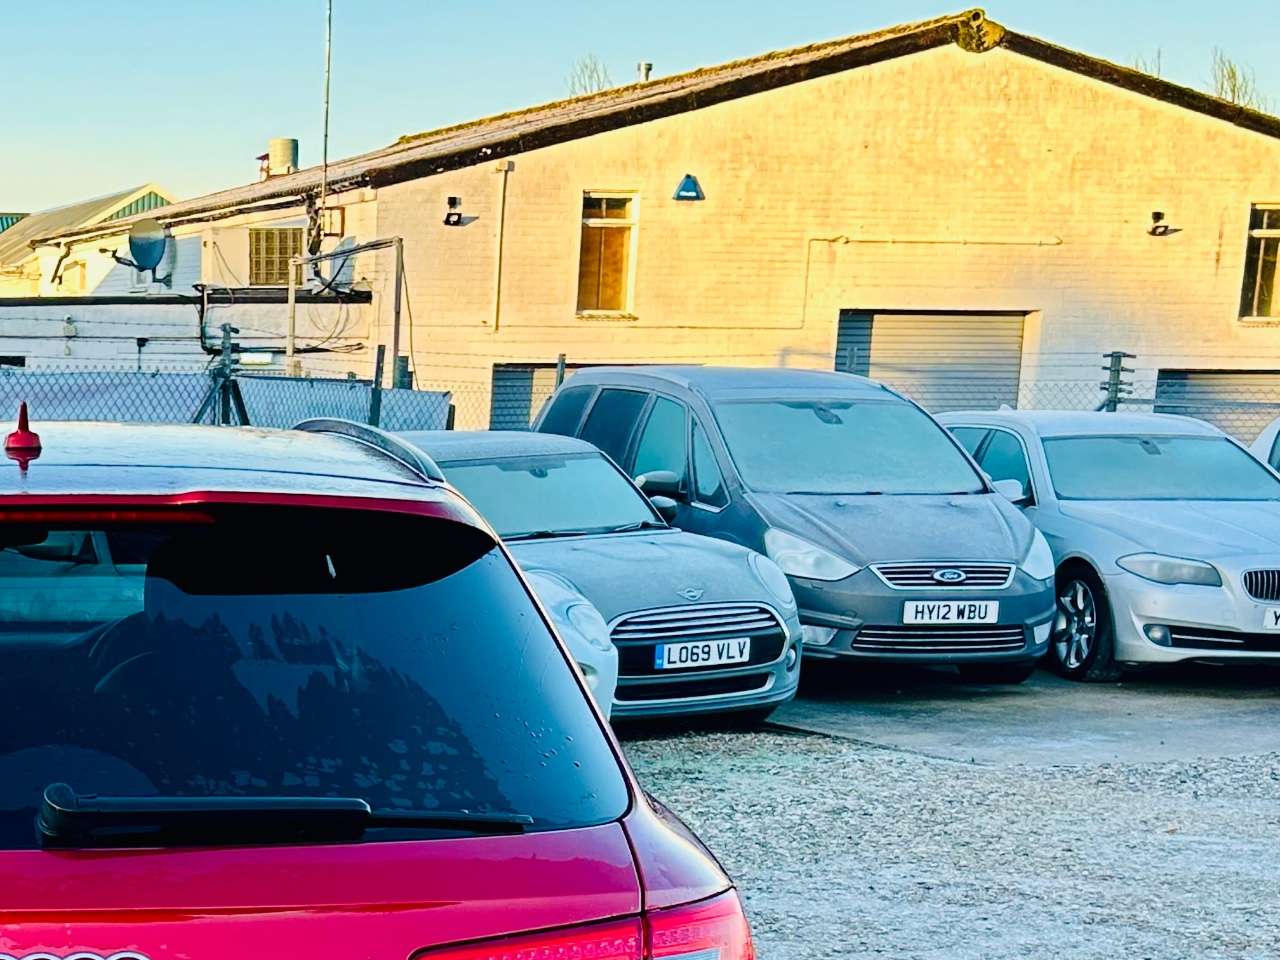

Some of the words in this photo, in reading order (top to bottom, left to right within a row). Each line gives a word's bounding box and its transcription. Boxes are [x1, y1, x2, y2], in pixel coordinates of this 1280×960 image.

[914, 603, 952, 621] HY12
[956, 603, 988, 621] WBU
[667, 644, 711, 665] LO69
[716, 641, 747, 661] VLV
